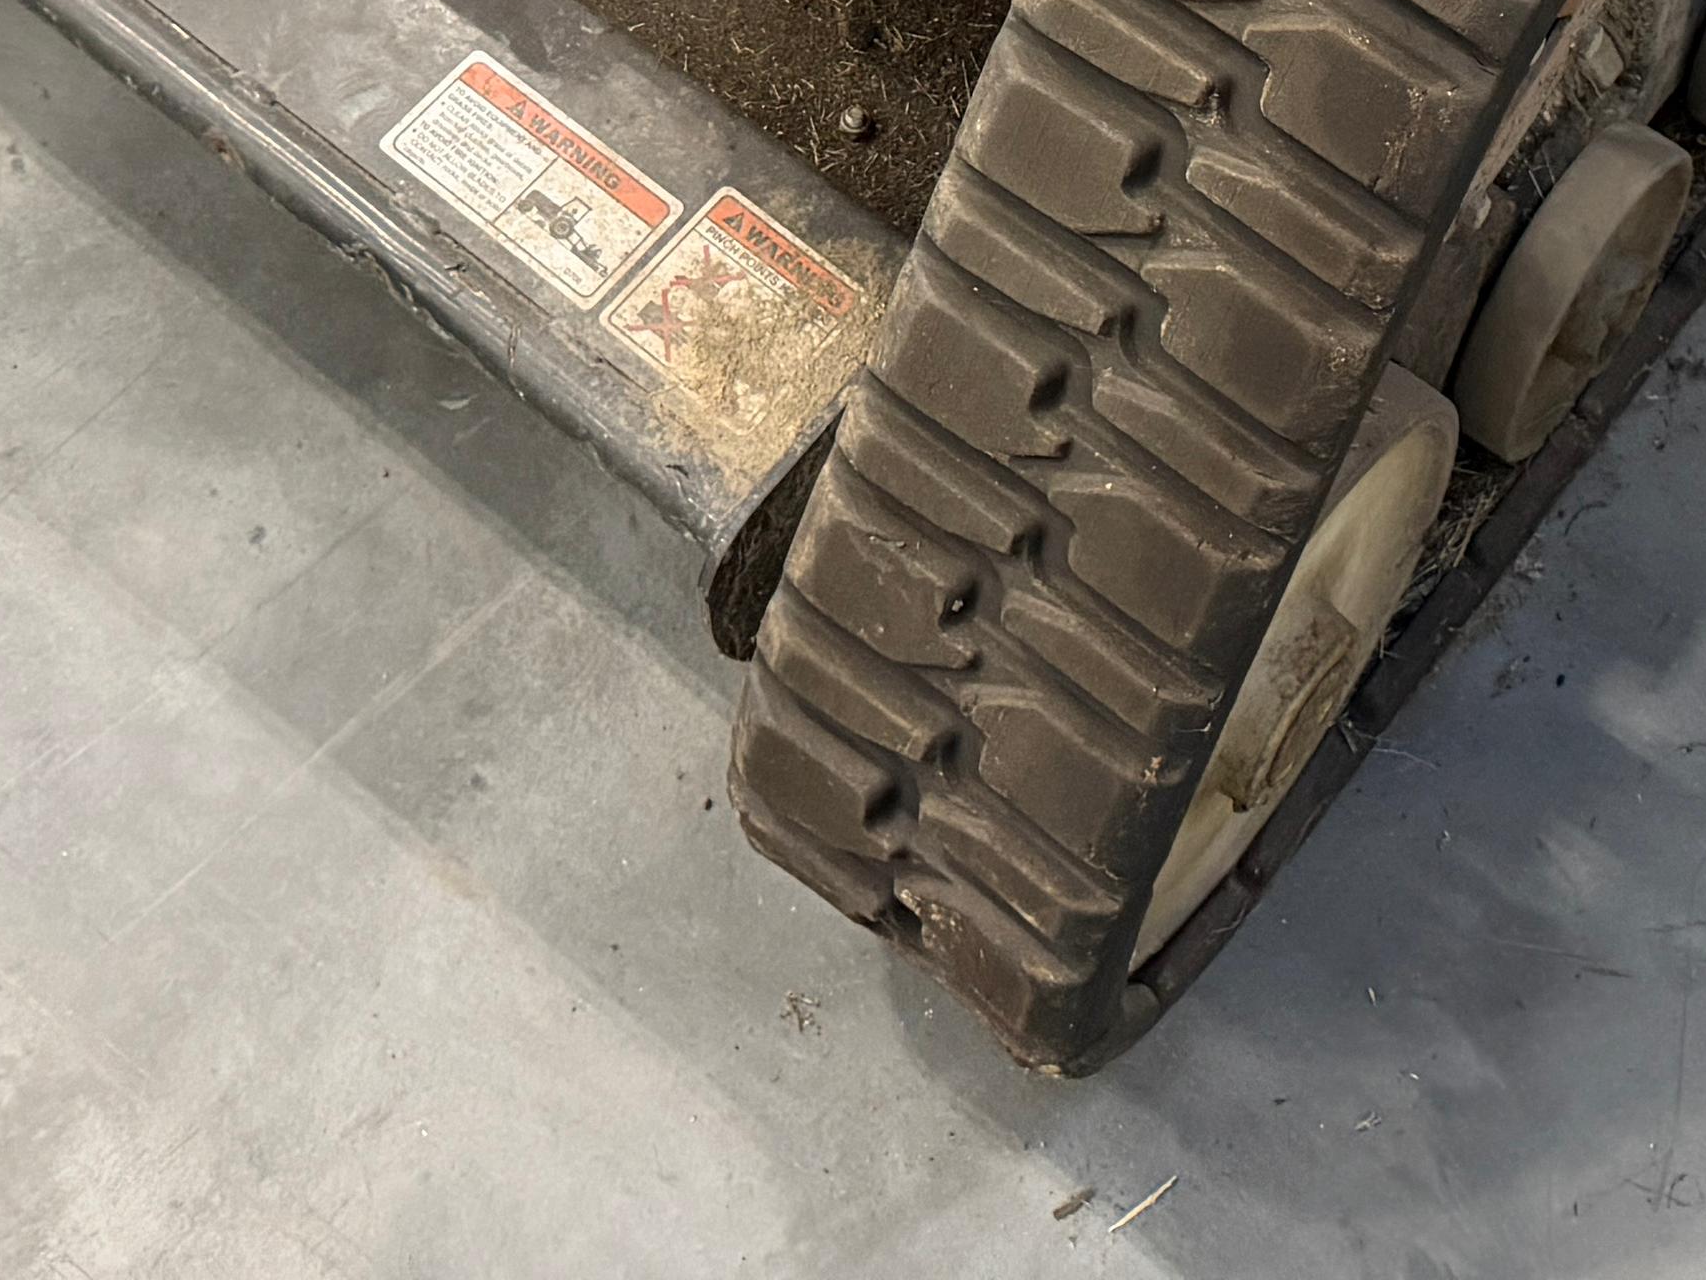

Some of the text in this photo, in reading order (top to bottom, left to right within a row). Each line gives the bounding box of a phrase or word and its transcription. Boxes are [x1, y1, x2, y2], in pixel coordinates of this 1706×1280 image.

[409, 137, 443, 166] CONTACT
[416, 130, 430, 144] DO
[427, 139, 445, 155] NOT
[493, 191, 507, 204] TO
[526, 112, 622, 192] WARNING
[705, 226, 780, 287] PINCH POINTS
